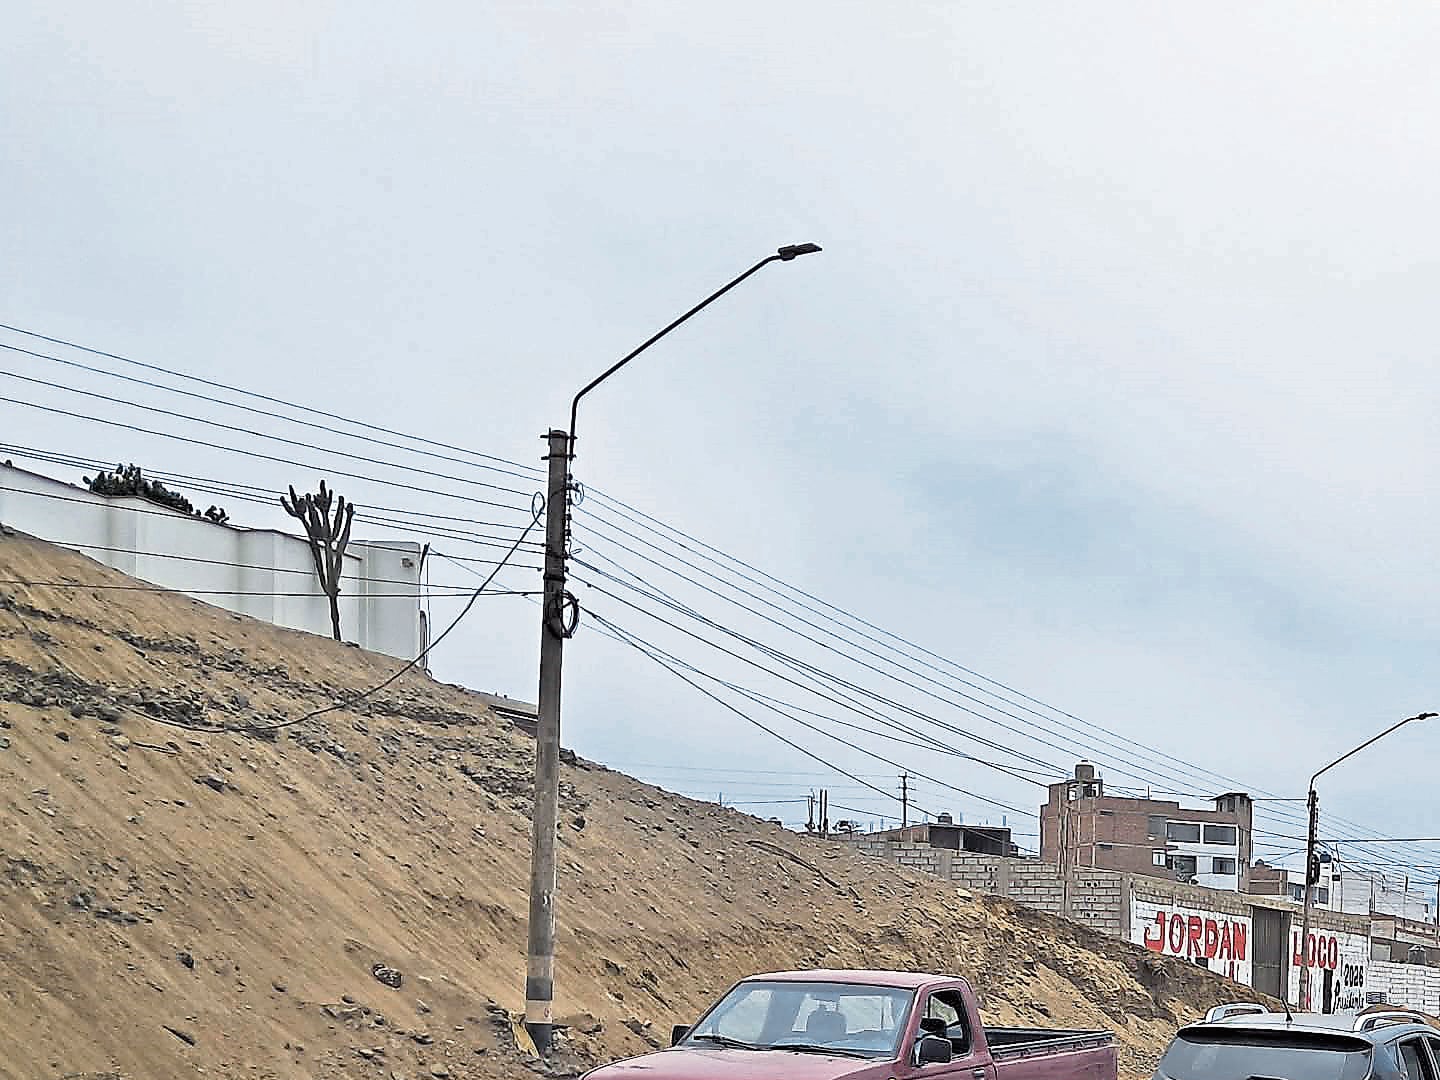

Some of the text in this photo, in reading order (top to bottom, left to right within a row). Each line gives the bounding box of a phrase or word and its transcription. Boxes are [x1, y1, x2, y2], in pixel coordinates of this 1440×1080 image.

[1144, 911, 1337, 969] JORDAN LOCO
[1343, 963, 1364, 987] 2026
